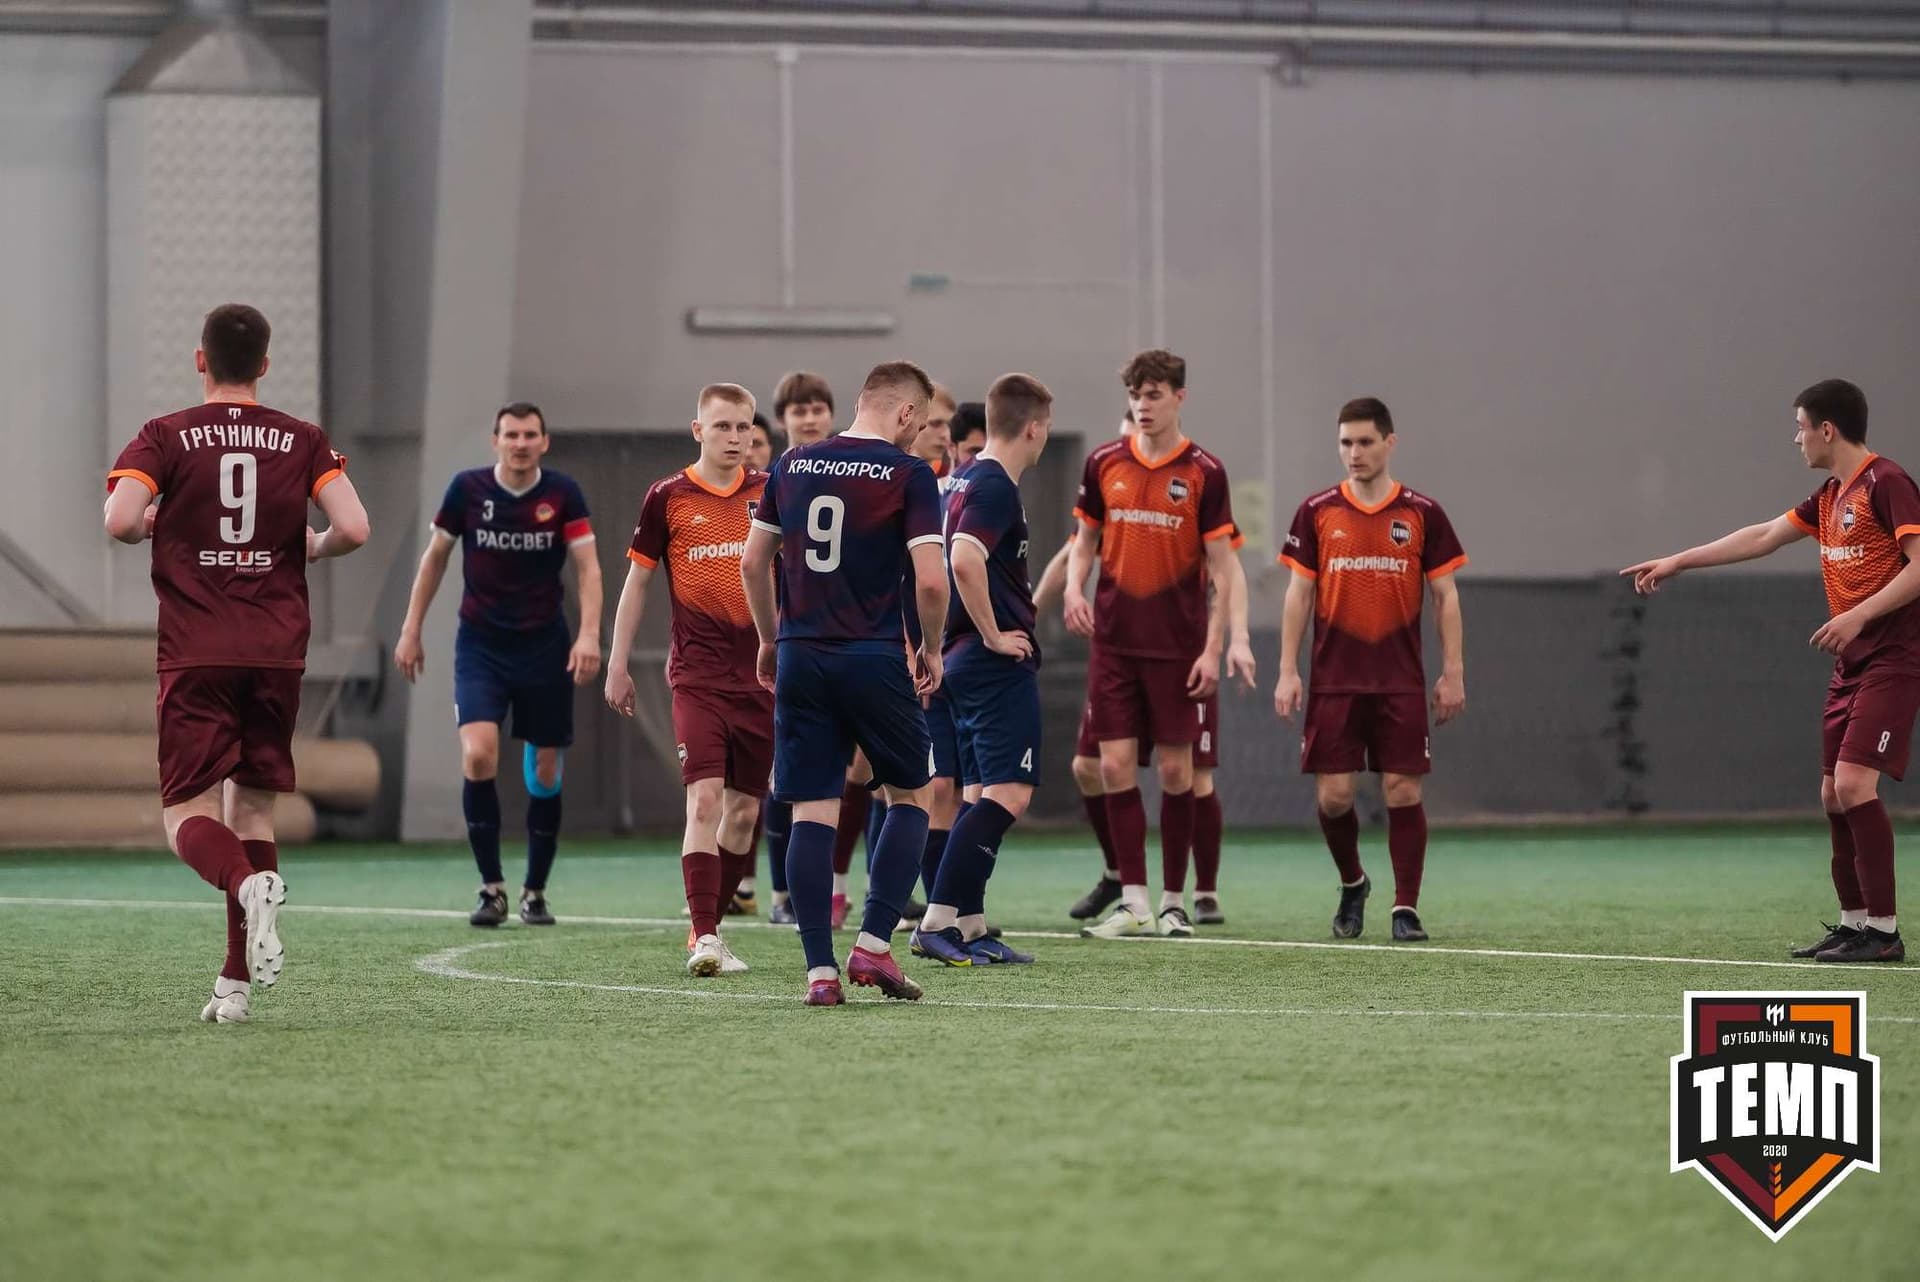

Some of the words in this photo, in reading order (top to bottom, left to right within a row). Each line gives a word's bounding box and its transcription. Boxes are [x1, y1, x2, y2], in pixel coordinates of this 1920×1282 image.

[179, 424, 295, 453] ГРЕЧНИКОВ
[787, 458, 895, 481] КРАСНОЯРСК
[219, 452, 258, 544] 9
[482, 499, 495, 521] 3
[475, 528, 556, 550] РАССВЕТ
[805, 495, 846, 573] 9
[199, 550, 272, 566] SEUS
[1877, 730, 1891, 753] 8
[1020, 747, 1033, 773] 4
